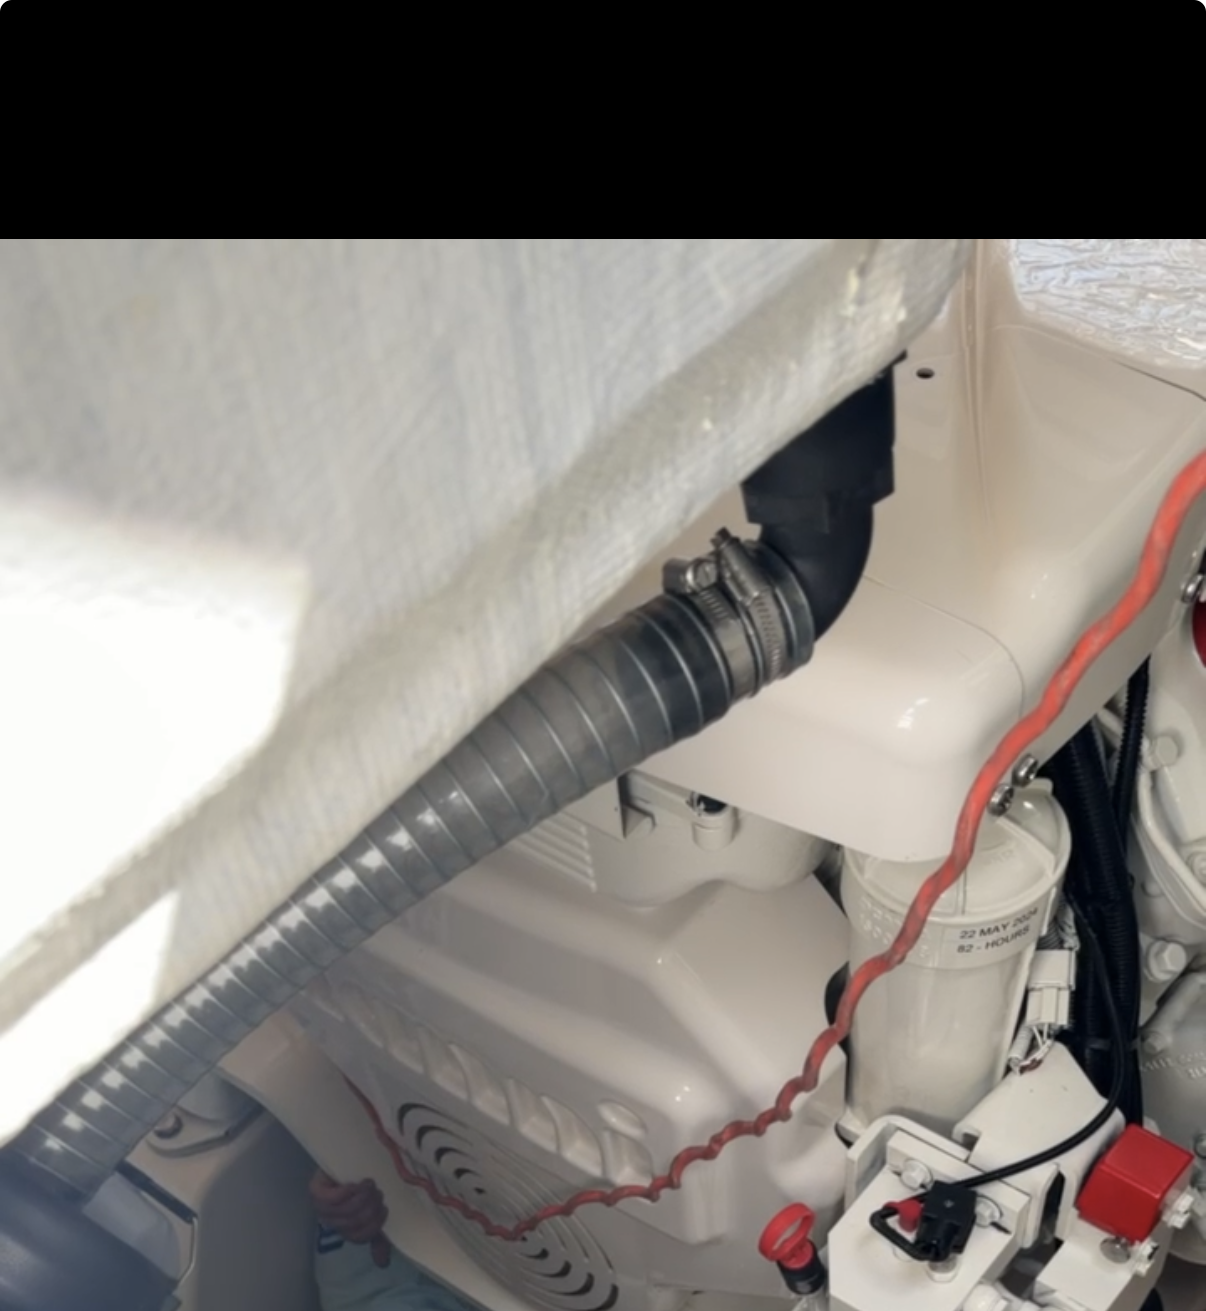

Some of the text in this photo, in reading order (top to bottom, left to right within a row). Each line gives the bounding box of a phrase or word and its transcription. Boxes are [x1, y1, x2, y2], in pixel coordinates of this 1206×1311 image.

[959, 929, 976, 940] 22
[979, 921, 1011, 937] MAY
[984, 924, 1031, 950] HOURS
